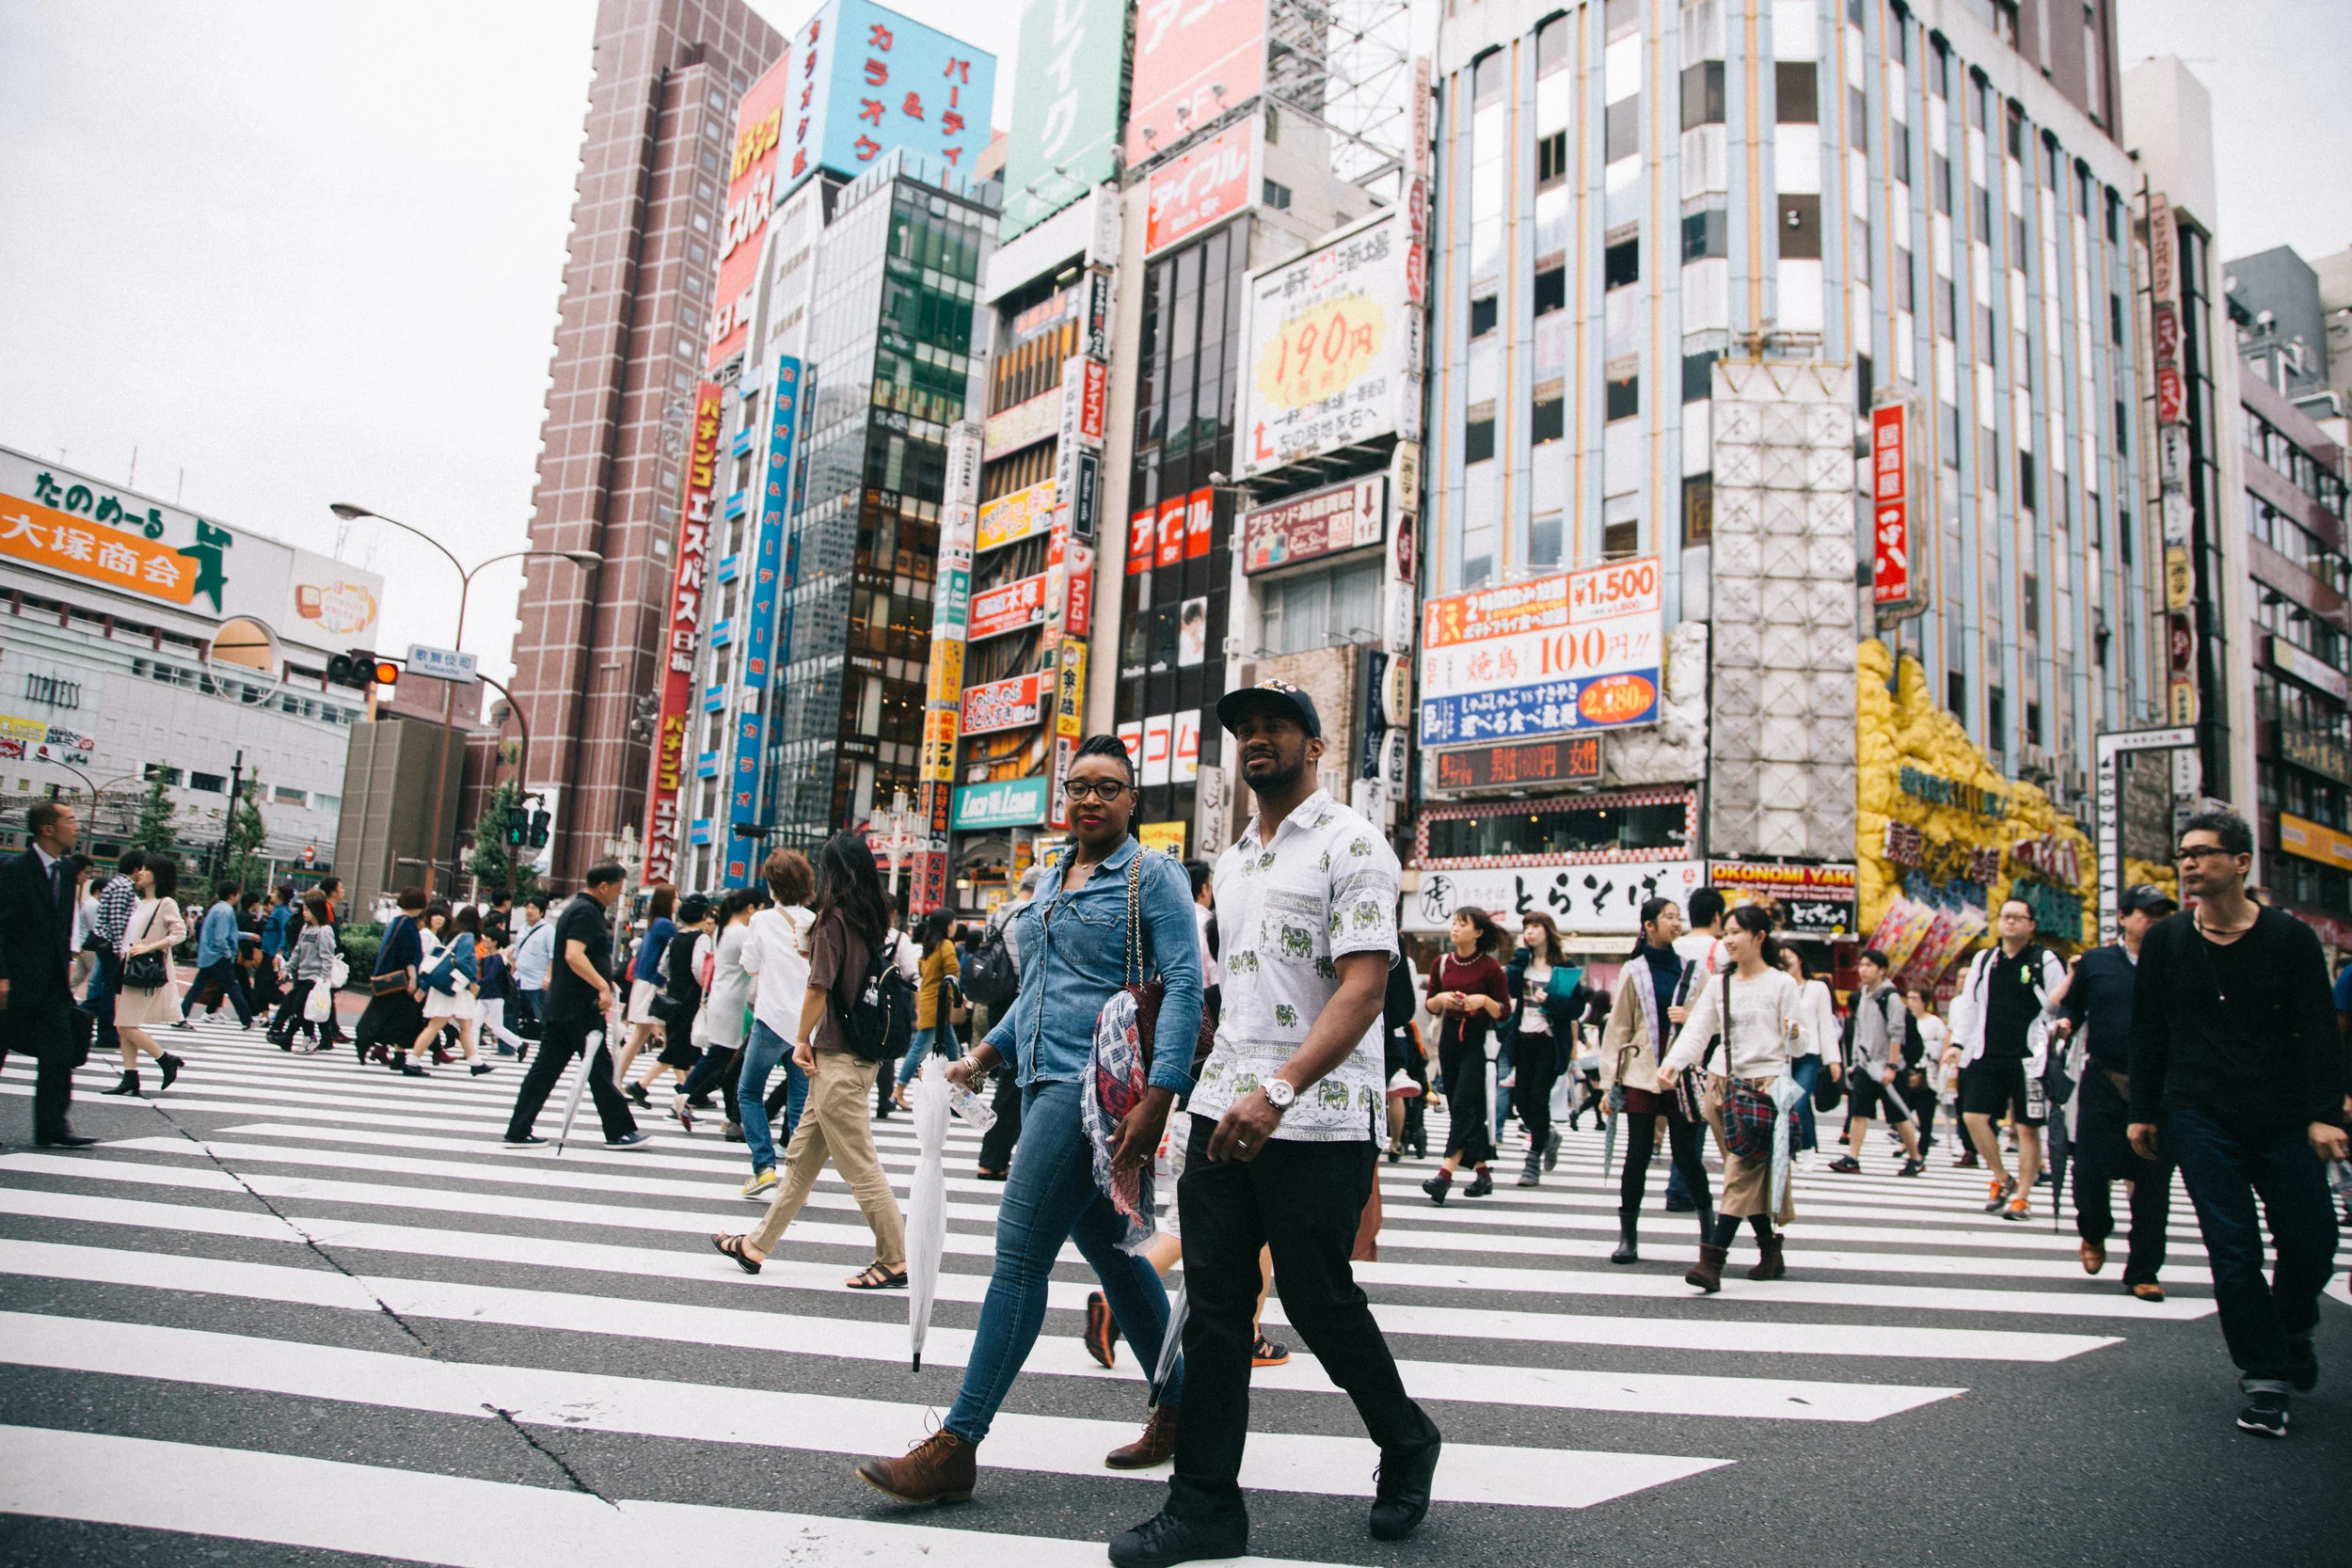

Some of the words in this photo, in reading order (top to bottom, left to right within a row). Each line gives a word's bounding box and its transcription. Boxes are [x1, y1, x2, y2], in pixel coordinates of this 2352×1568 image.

[854, 23, 893, 162] カラオケ
[902, 91, 924, 120] &
[1150, 144, 1248, 224] アイフル
[1276, 311, 1373, 385] 190円
[1085, 379, 1102, 435] アイフル
[691, 397, 721, 488] パチンコ
[34, 471, 165, 540] たのめーる
[1132, 499, 1213, 552] アイフル
[0, 513, 182, 588] 大塚商会
[675, 492, 709, 625] エスパス
[1071, 578, 1086, 621] アコム
[1575, 565, 1654, 607] ¥1,500
[415, 647, 472, 671] 歌舞伎町
[966, 679, 1025, 710] しゃぶしゃぶ
[1060, 669, 1078, 717] 金の蔵
[1459, 701, 1579, 738] 選べる食べ放題
[1461, 689, 1519, 714] しゃぶしゃぶ
[1534, 681, 1579, 705] すきやき
[659, 713, 686, 791] パチンコ
[1053, 737, 1070, 821] 東京チカラめし
[647, 798, 675, 883] エスパス
[1424, 874, 1452, 920] 虎
[1515, 867, 1668, 916] とらそば
[1712, 863, 1804, 883] OKONOMI
[1808, 867, 1855, 886] YAKI
